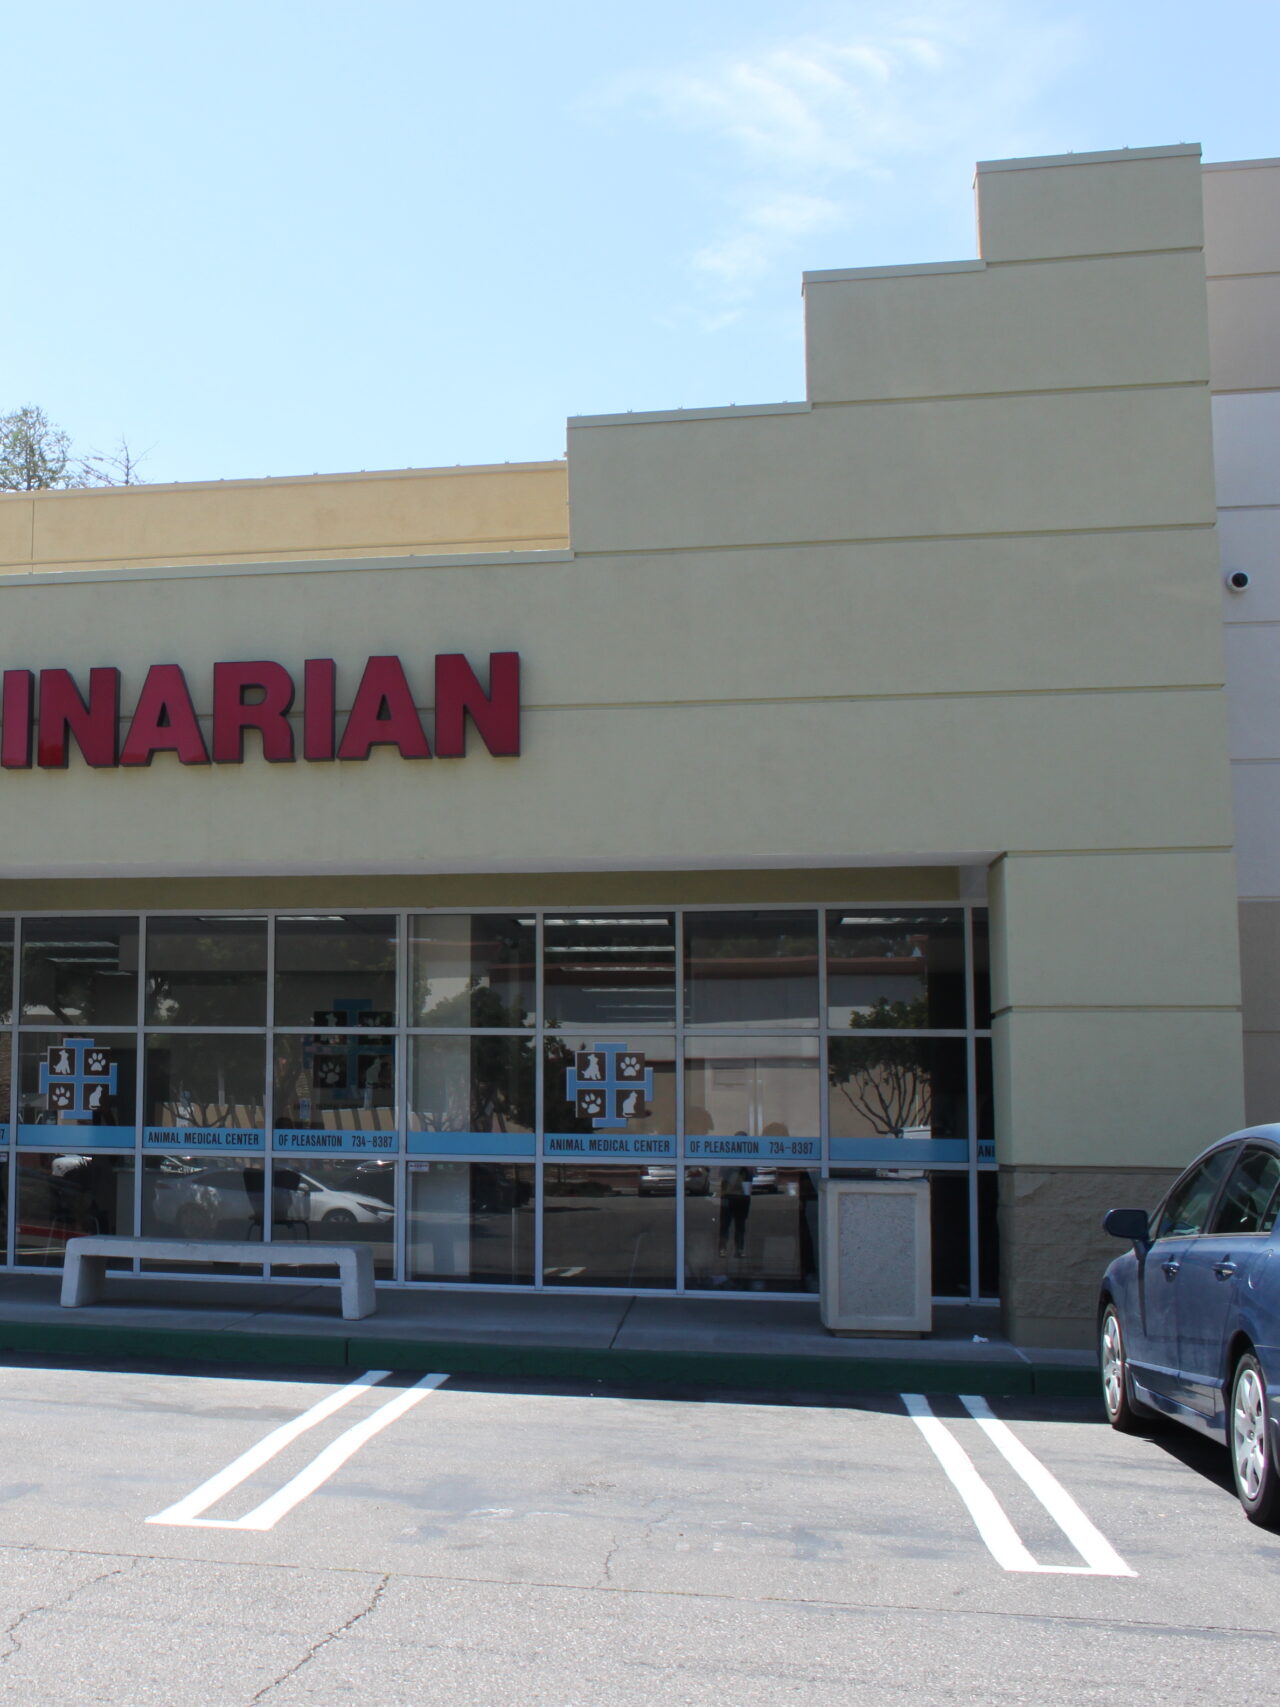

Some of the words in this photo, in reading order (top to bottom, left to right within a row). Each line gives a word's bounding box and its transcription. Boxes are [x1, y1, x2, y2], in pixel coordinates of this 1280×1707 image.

[148, 1132, 181, 1144] ANIMAL
[184, 1132, 221, 1145] MEDICAL
[225, 1133, 259, 1146] CENTER
[278, 1134, 289, 1146] OF
[291, 1134, 343, 1147] PLEASANTON
[351, 1135, 393, 1148] 734-8387
[549, 1139, 585, 1151] ANIMAL
[588, 1139, 631, 1152] MEDICAL
[633, 1140, 670, 1153] CENTER
[689, 1141, 700, 1153] OF
[704, 1141, 760, 1154] PLEASANTON
[769, 1142, 814, 1155] 734-8387
